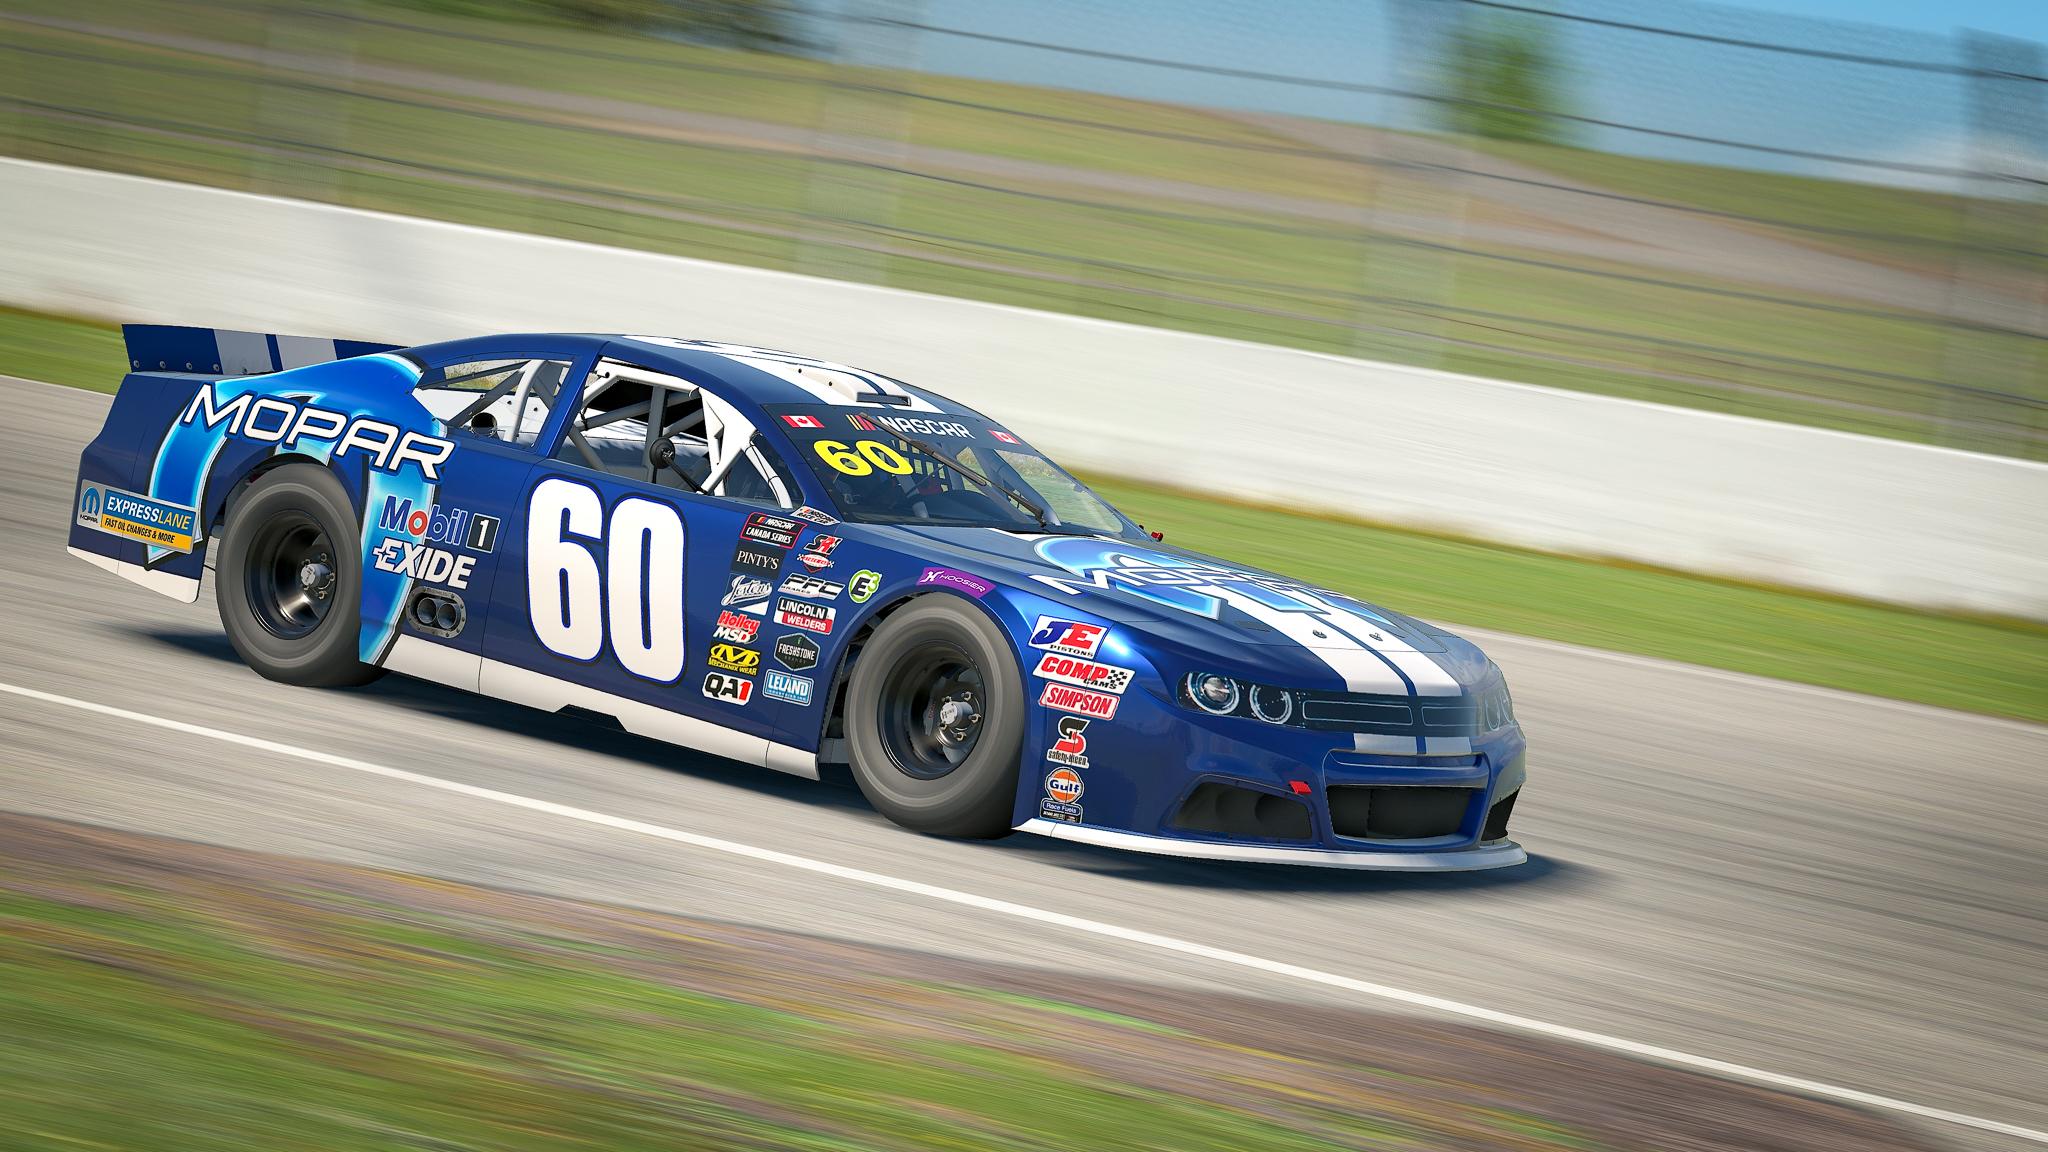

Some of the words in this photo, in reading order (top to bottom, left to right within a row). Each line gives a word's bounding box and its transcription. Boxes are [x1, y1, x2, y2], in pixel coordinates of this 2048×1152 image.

[184, 383, 456, 480] MOPAR
[876, 415, 976, 440] NASCAR
[813, 439, 914, 477] 60
[104, 517, 117, 529] FAST
[118, 521, 126, 531] OIL
[126, 523, 152, 539] CHANGES
[151, 530, 157, 539] &
[157, 531, 176, 544] MORE
[379, 495, 468, 546] Mobil
[764, 518, 796, 531] NASCAR
[745, 526, 771, 540] CANADA
[771, 532, 793, 544] SERIES
[373, 538, 477, 590] EXIDE
[736, 550, 780, 570] PINTY'S
[527, 478, 685, 682] 60
[784, 574, 844, 596] PFC
[940, 574, 986, 593] HOOSIER
[779, 599, 826, 619] LINCOLN
[717, 610, 760, 635] Holley
[787, 614, 827, 631] WELDERS
[713, 627, 752, 644] MSD
[1031, 621, 1102, 650] JE
[778, 643, 816, 661] FRESHSTONE
[1049, 644, 1094, 658] PISTONS
[708, 657, 738, 672] MECHANIX
[739, 667, 758, 676] WEAR
[1041, 656, 1109, 681] COMP
[704, 673, 752, 701] QA1
[768, 674, 809, 696] LELAND
[1083, 678, 1117, 690] CAMS
[1046, 687, 1113, 715] SIMPSON
[1049, 780, 1080, 793] Gulf
